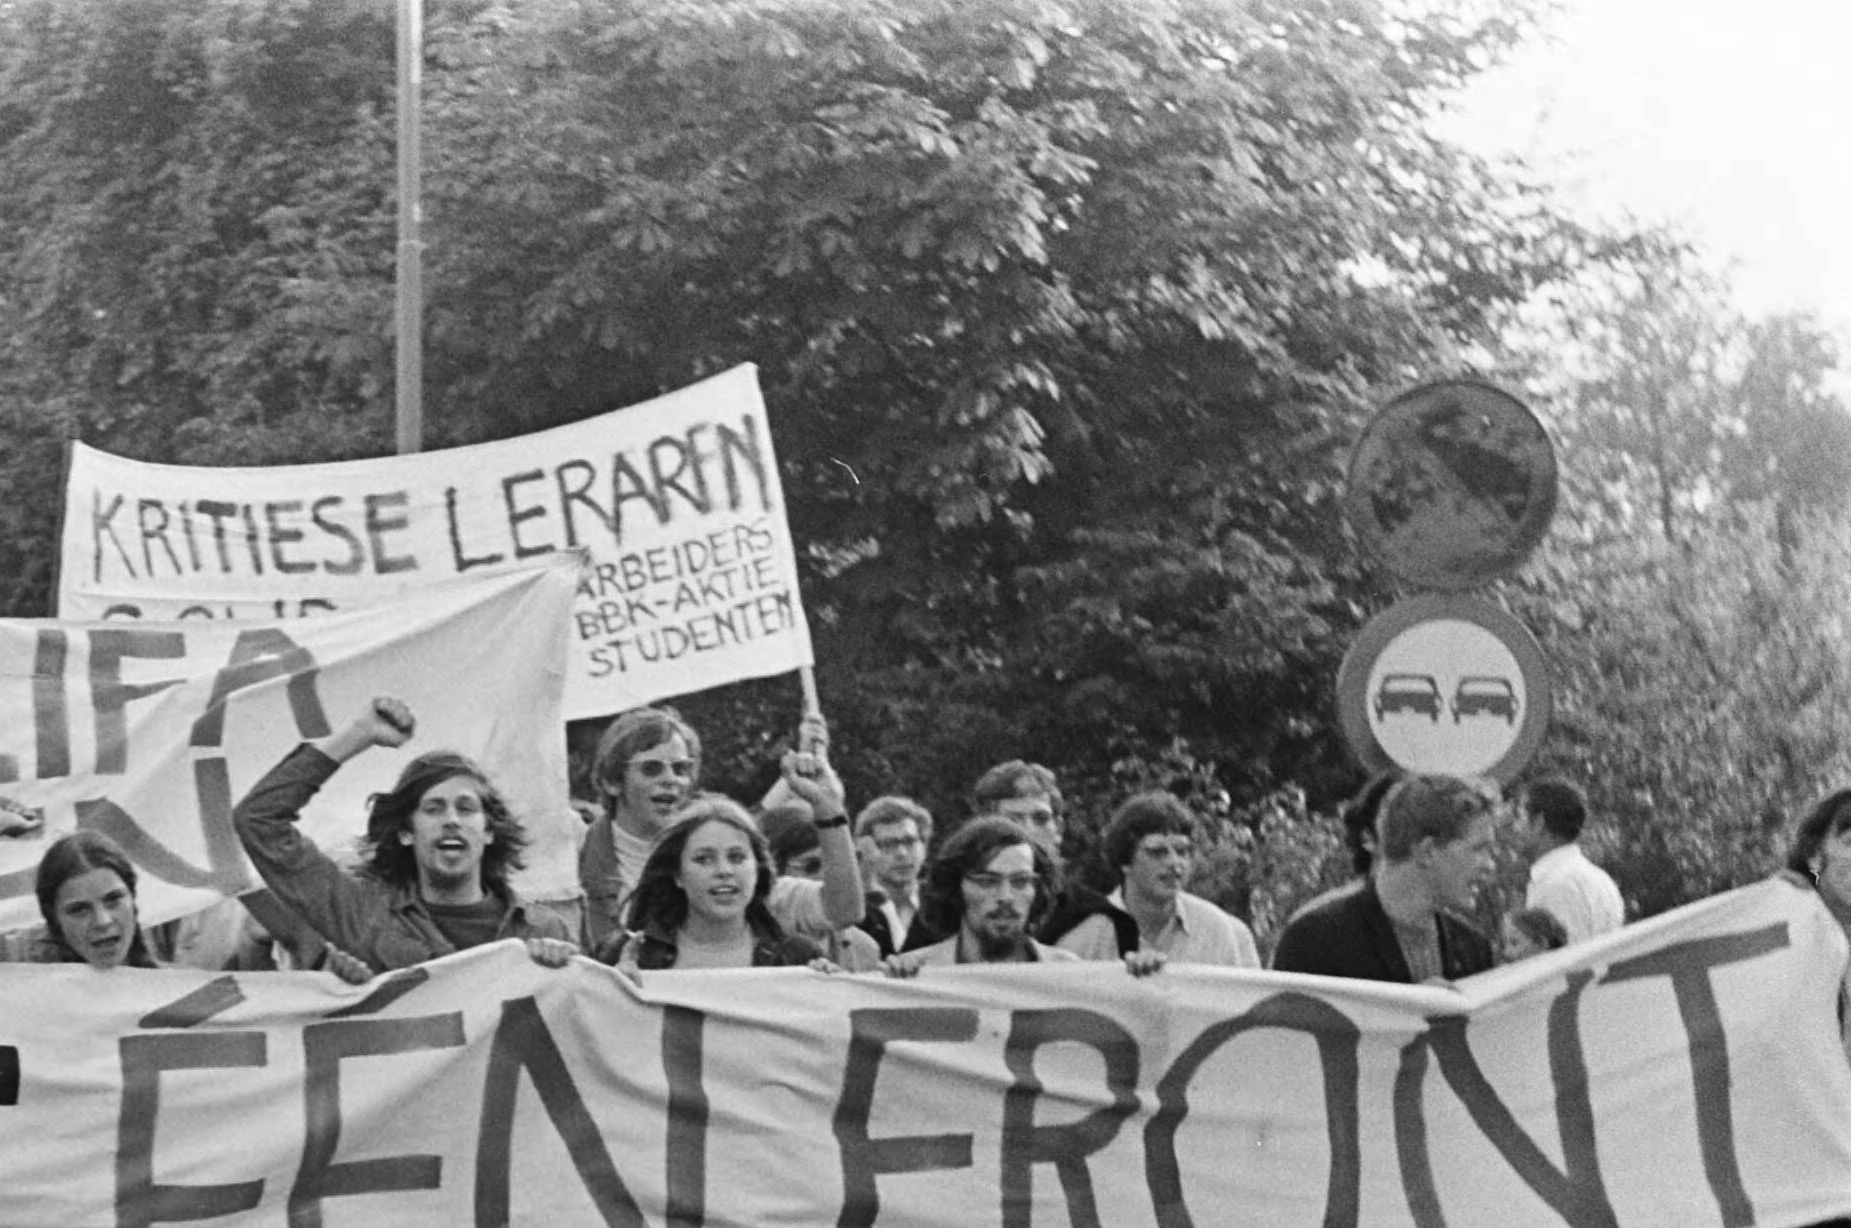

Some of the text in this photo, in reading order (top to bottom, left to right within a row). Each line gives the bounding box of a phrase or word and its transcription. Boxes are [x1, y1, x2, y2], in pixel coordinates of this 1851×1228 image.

[93, 487, 418, 583] KRITIESE
[575, 516, 773, 600] ARBEIDERS
[575, 556, 780, 641] BBK-AKTIE
[589, 590, 795, 678] STUDENTEN
